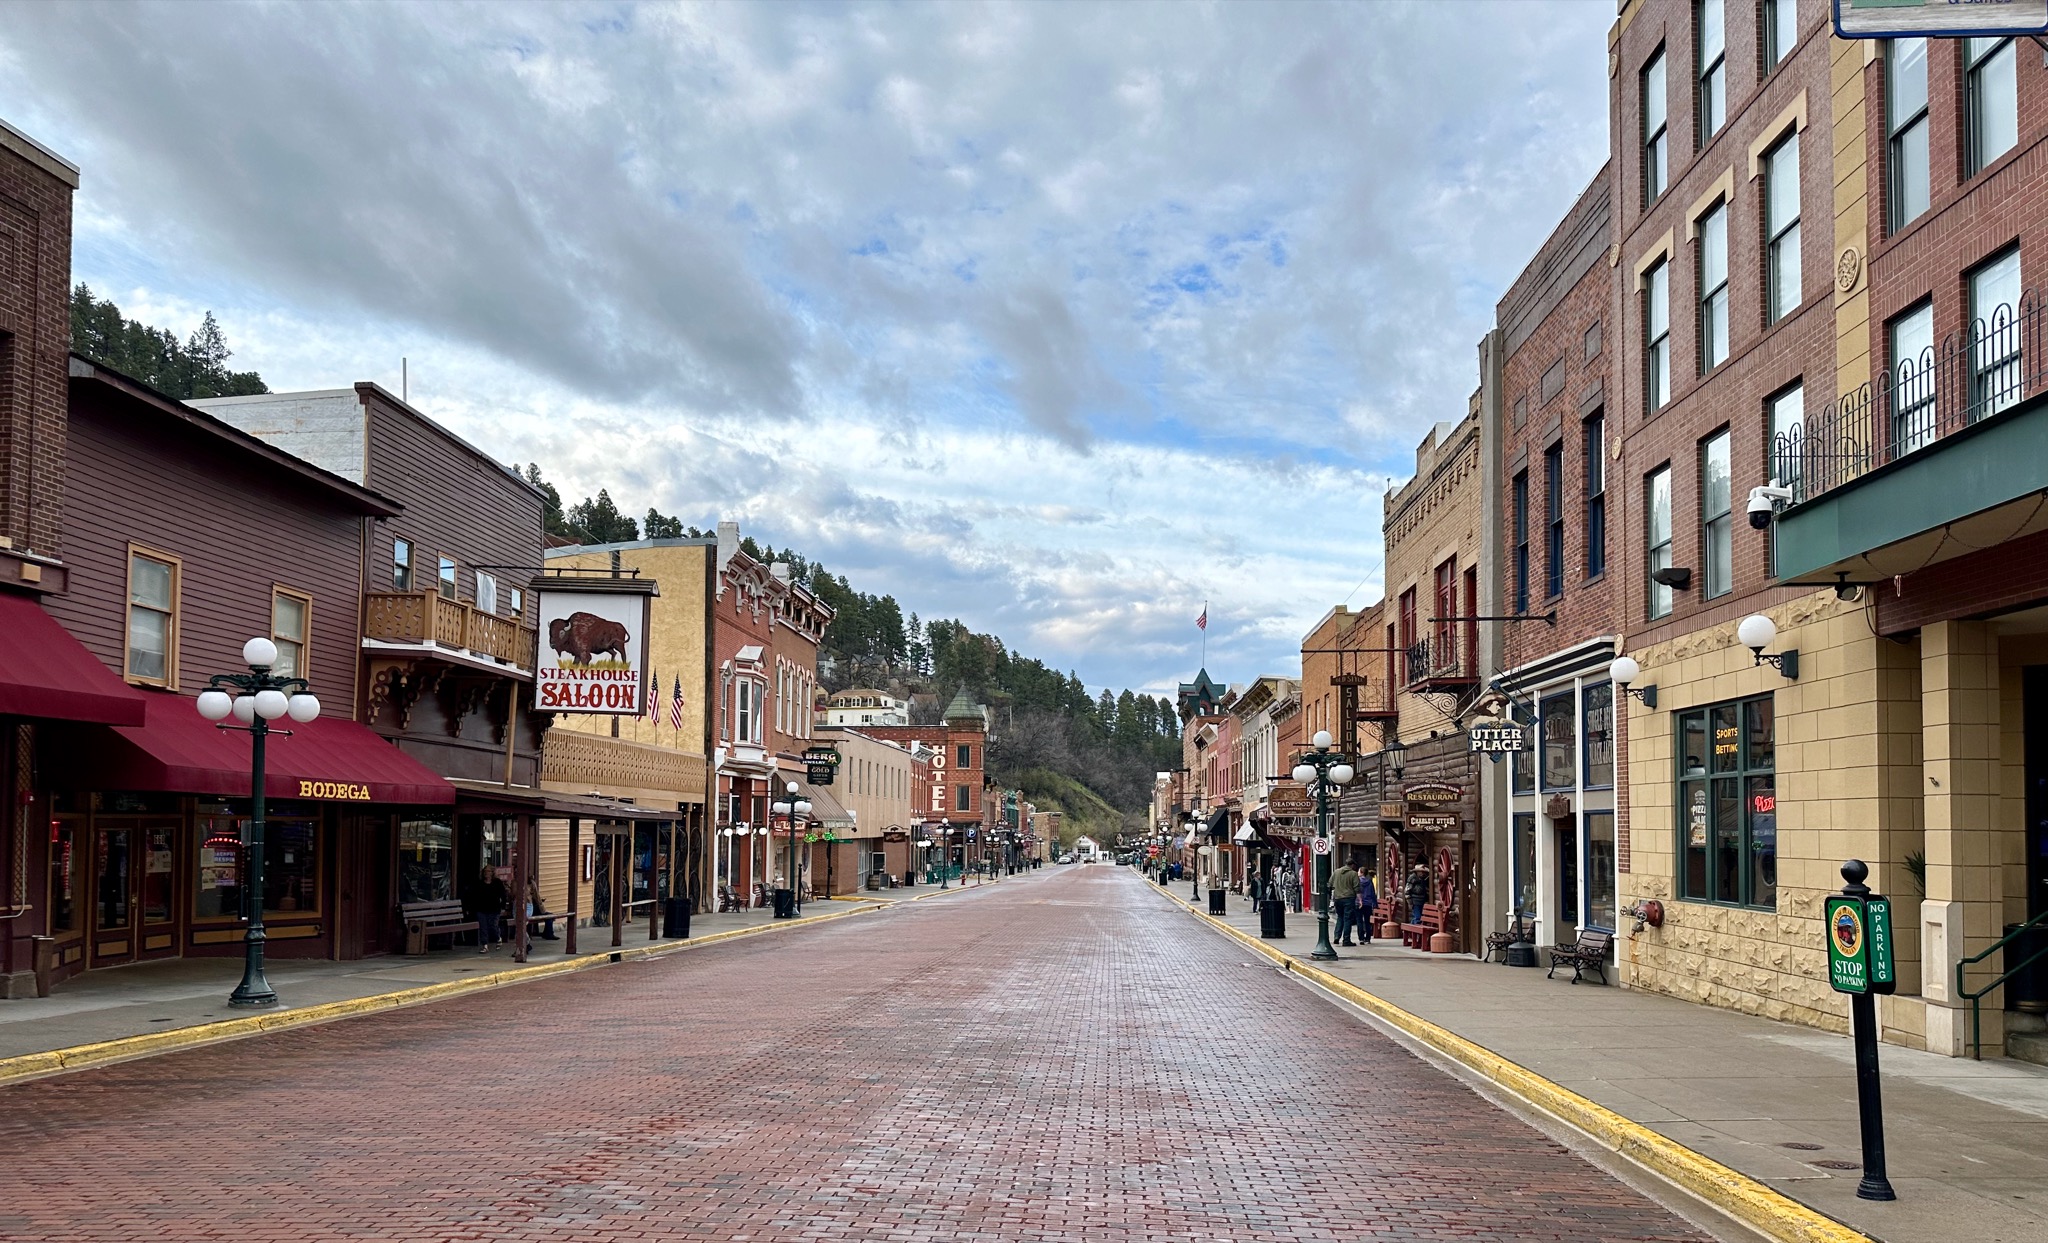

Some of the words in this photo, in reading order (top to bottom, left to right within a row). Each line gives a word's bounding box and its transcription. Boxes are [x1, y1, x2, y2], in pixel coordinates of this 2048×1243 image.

[540, 668, 638, 681] STEAKHOUSE
[541, 682, 636, 709] SALOON
[1471, 729, 1522, 739] UTTER
[1716, 727, 1738, 739] SPORTS
[1471, 740, 1522, 751] PLACE
[805, 753, 836, 761] BERG
[932, 745, 946, 811] HOTEL
[299, 780, 371, 800] BODEGA
[1407, 793, 1458, 801] RESTAURANT
[1870, 904, 1885, 913] NO
[1874, 915, 1887, 980] PARKING
[1835, 960, 1863, 976] STOP
[1843, 976, 1866, 987] PARKING
